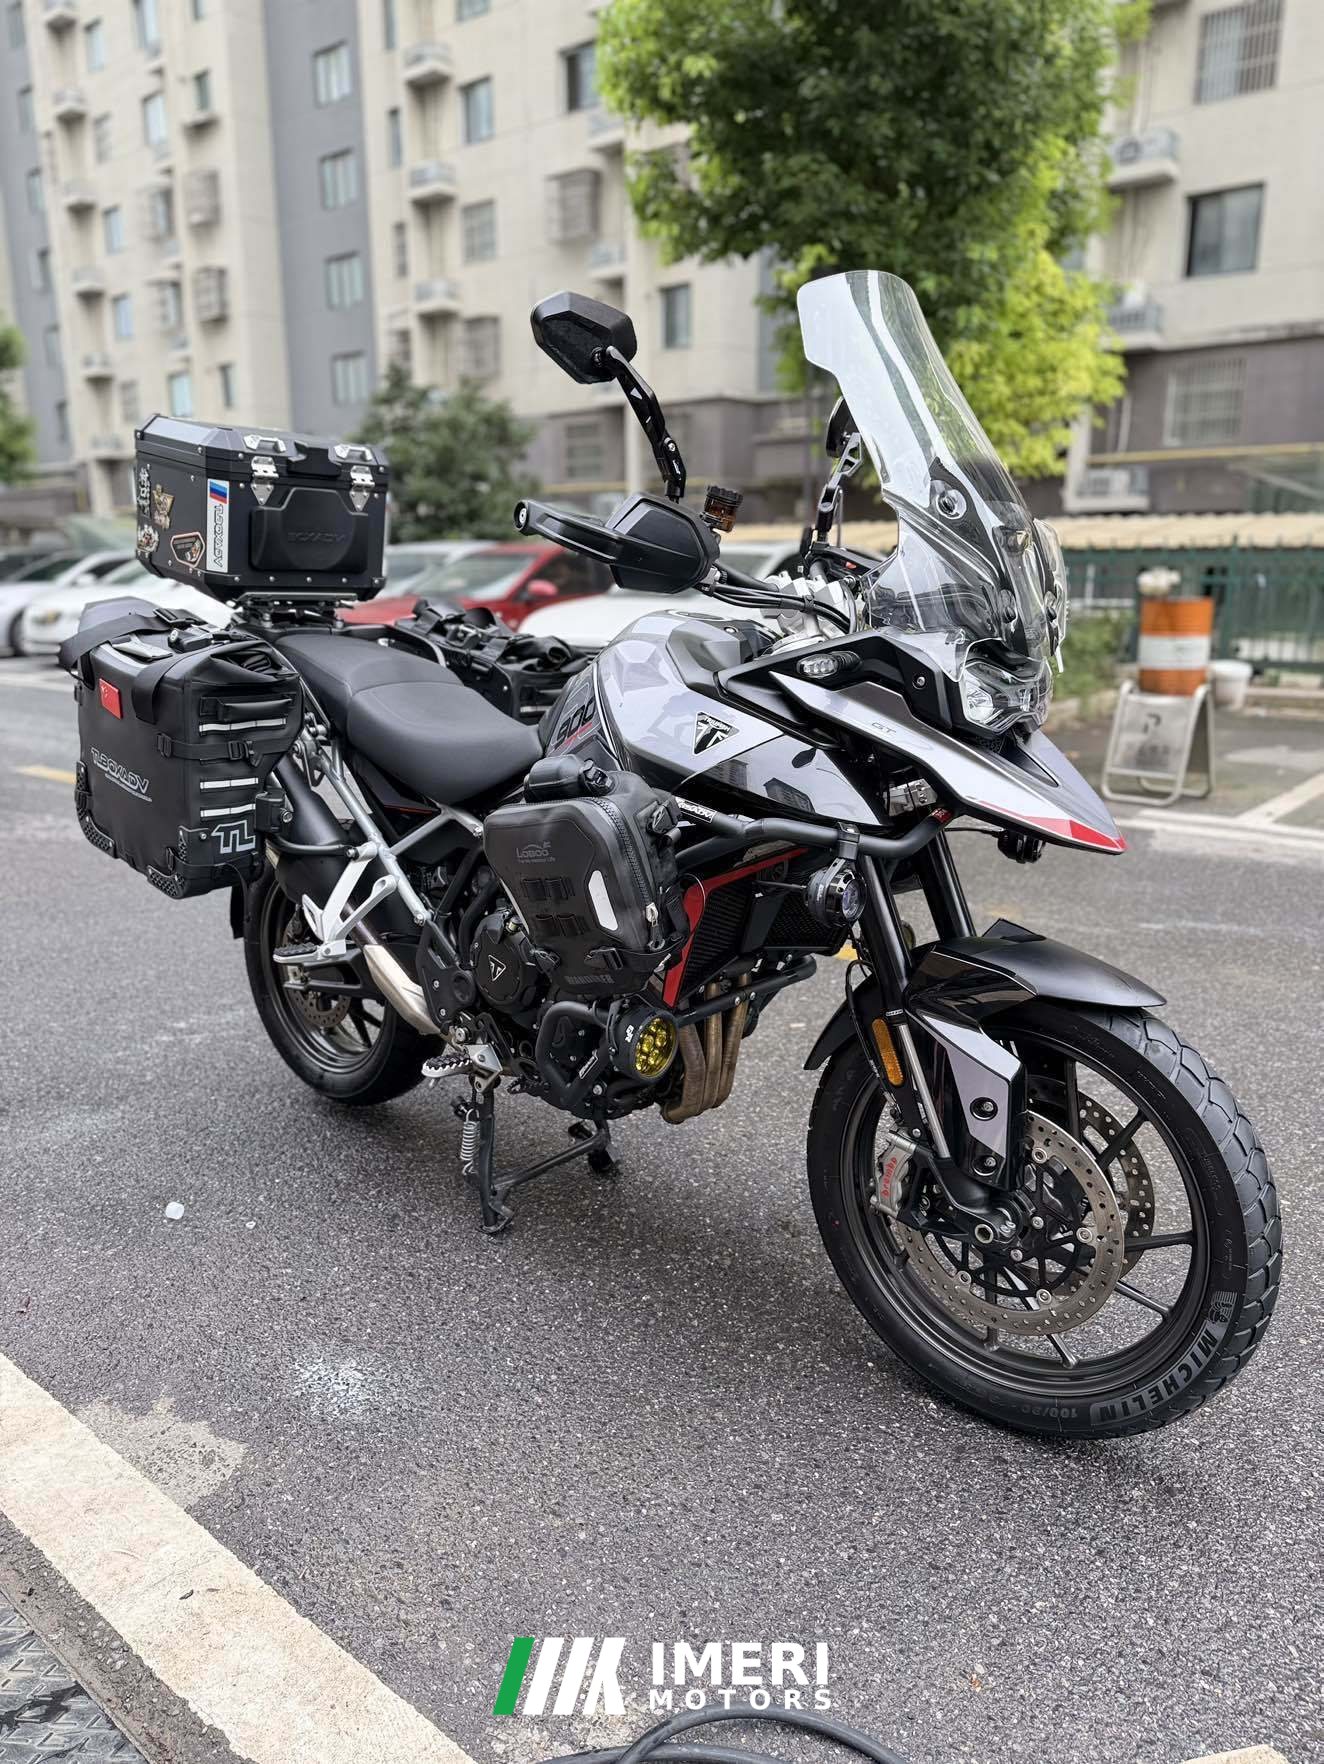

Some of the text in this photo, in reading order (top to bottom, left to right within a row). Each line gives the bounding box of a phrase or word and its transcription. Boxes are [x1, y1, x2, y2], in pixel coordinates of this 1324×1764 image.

[210, 819, 256, 854] TL
[881, 1156, 897, 1199] brembo
[1100, 1327, 1218, 1422] MICHELIN
